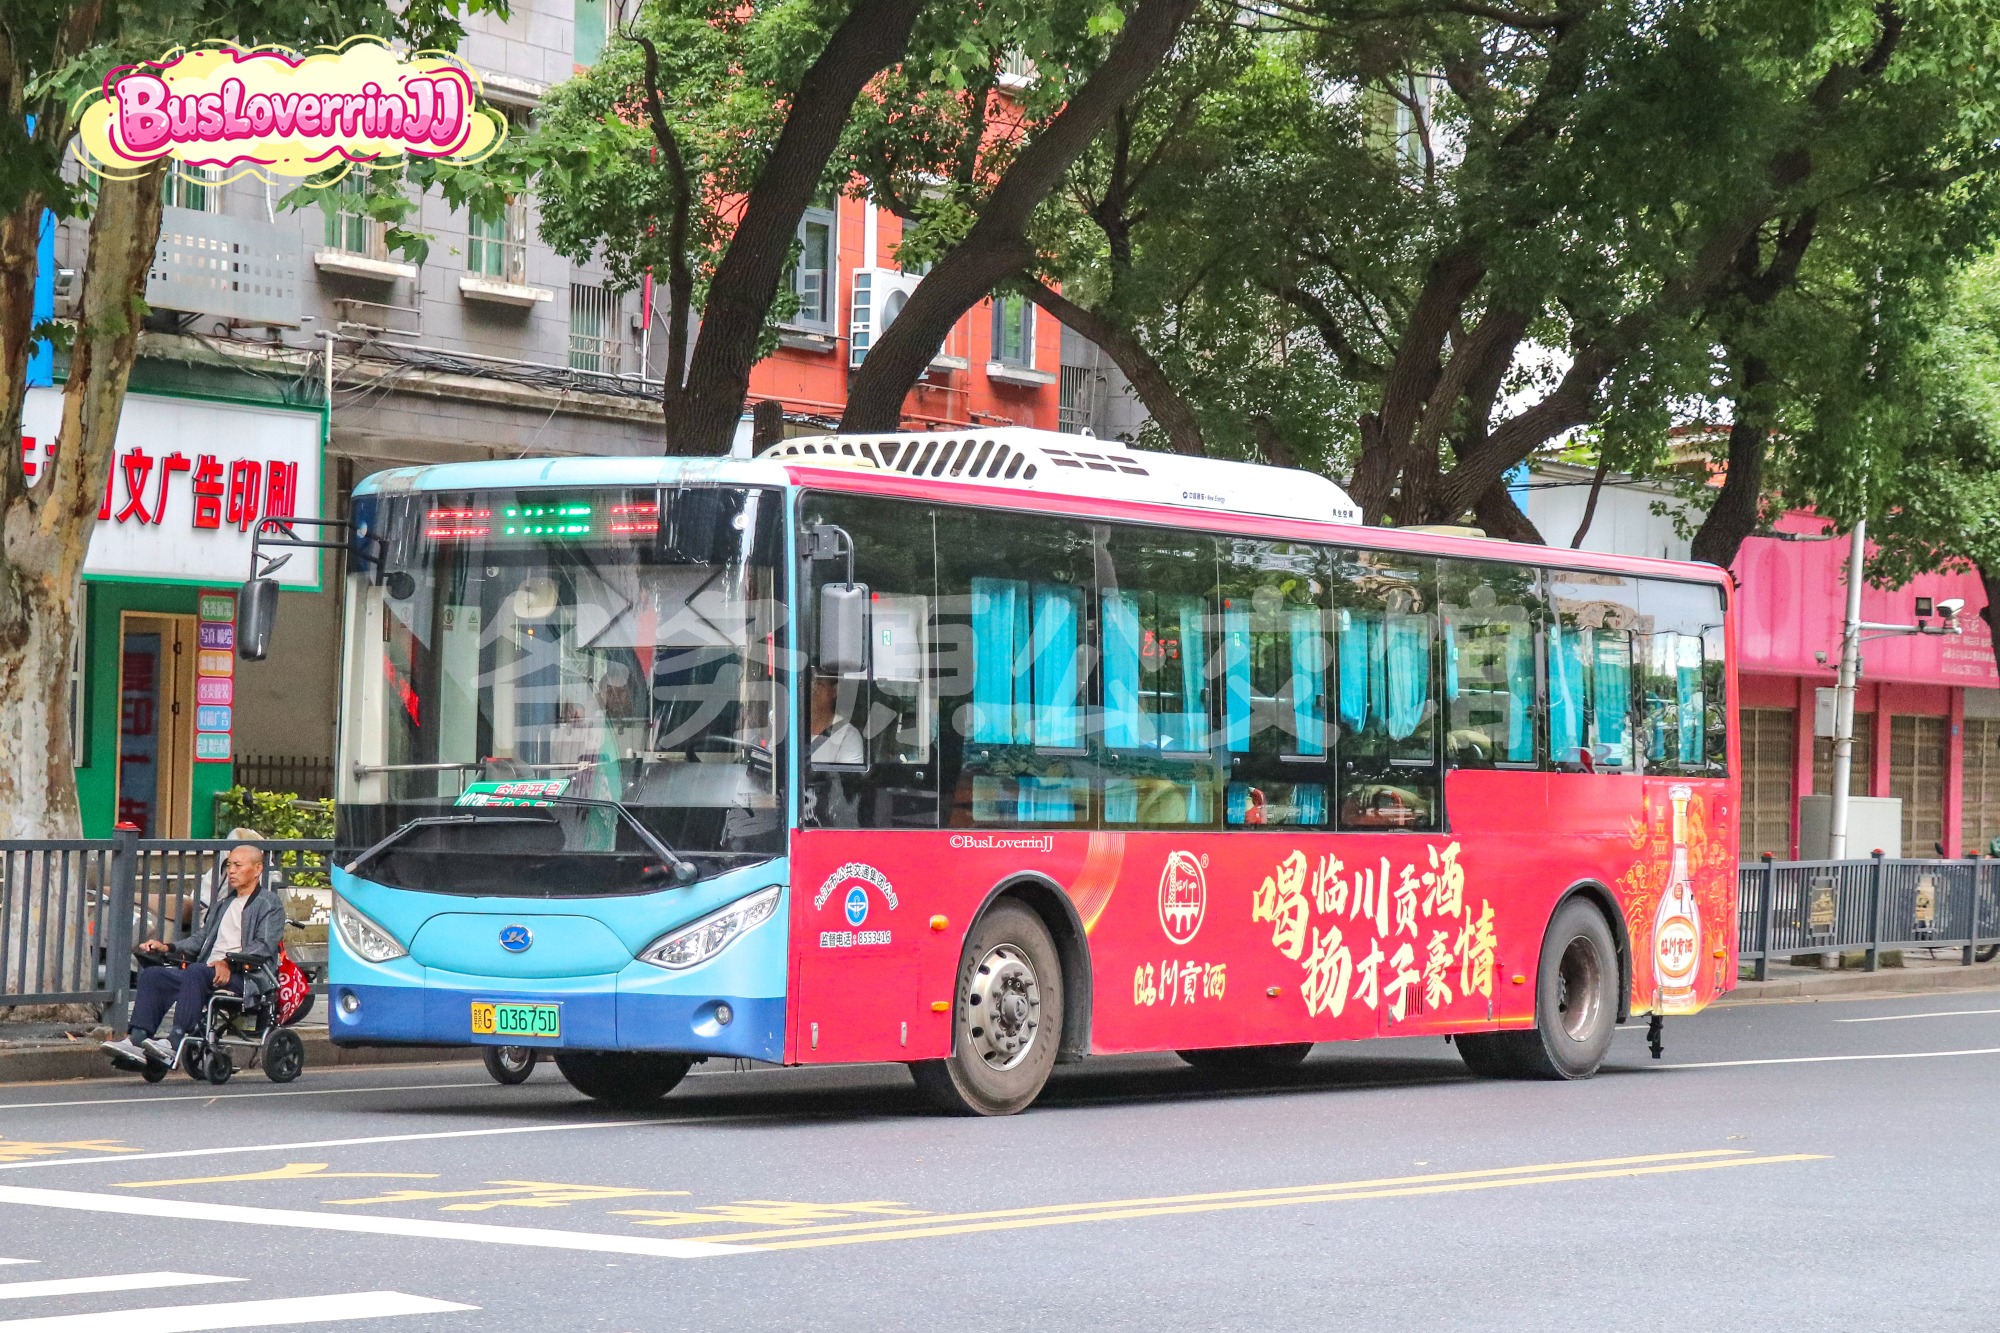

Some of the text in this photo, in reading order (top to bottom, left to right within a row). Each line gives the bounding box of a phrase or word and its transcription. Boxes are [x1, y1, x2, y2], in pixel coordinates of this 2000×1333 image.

[814, 862, 899, 911] 九江市公共交通集团公司
[1300, 898, 1498, 1023] 扬才子豪情
